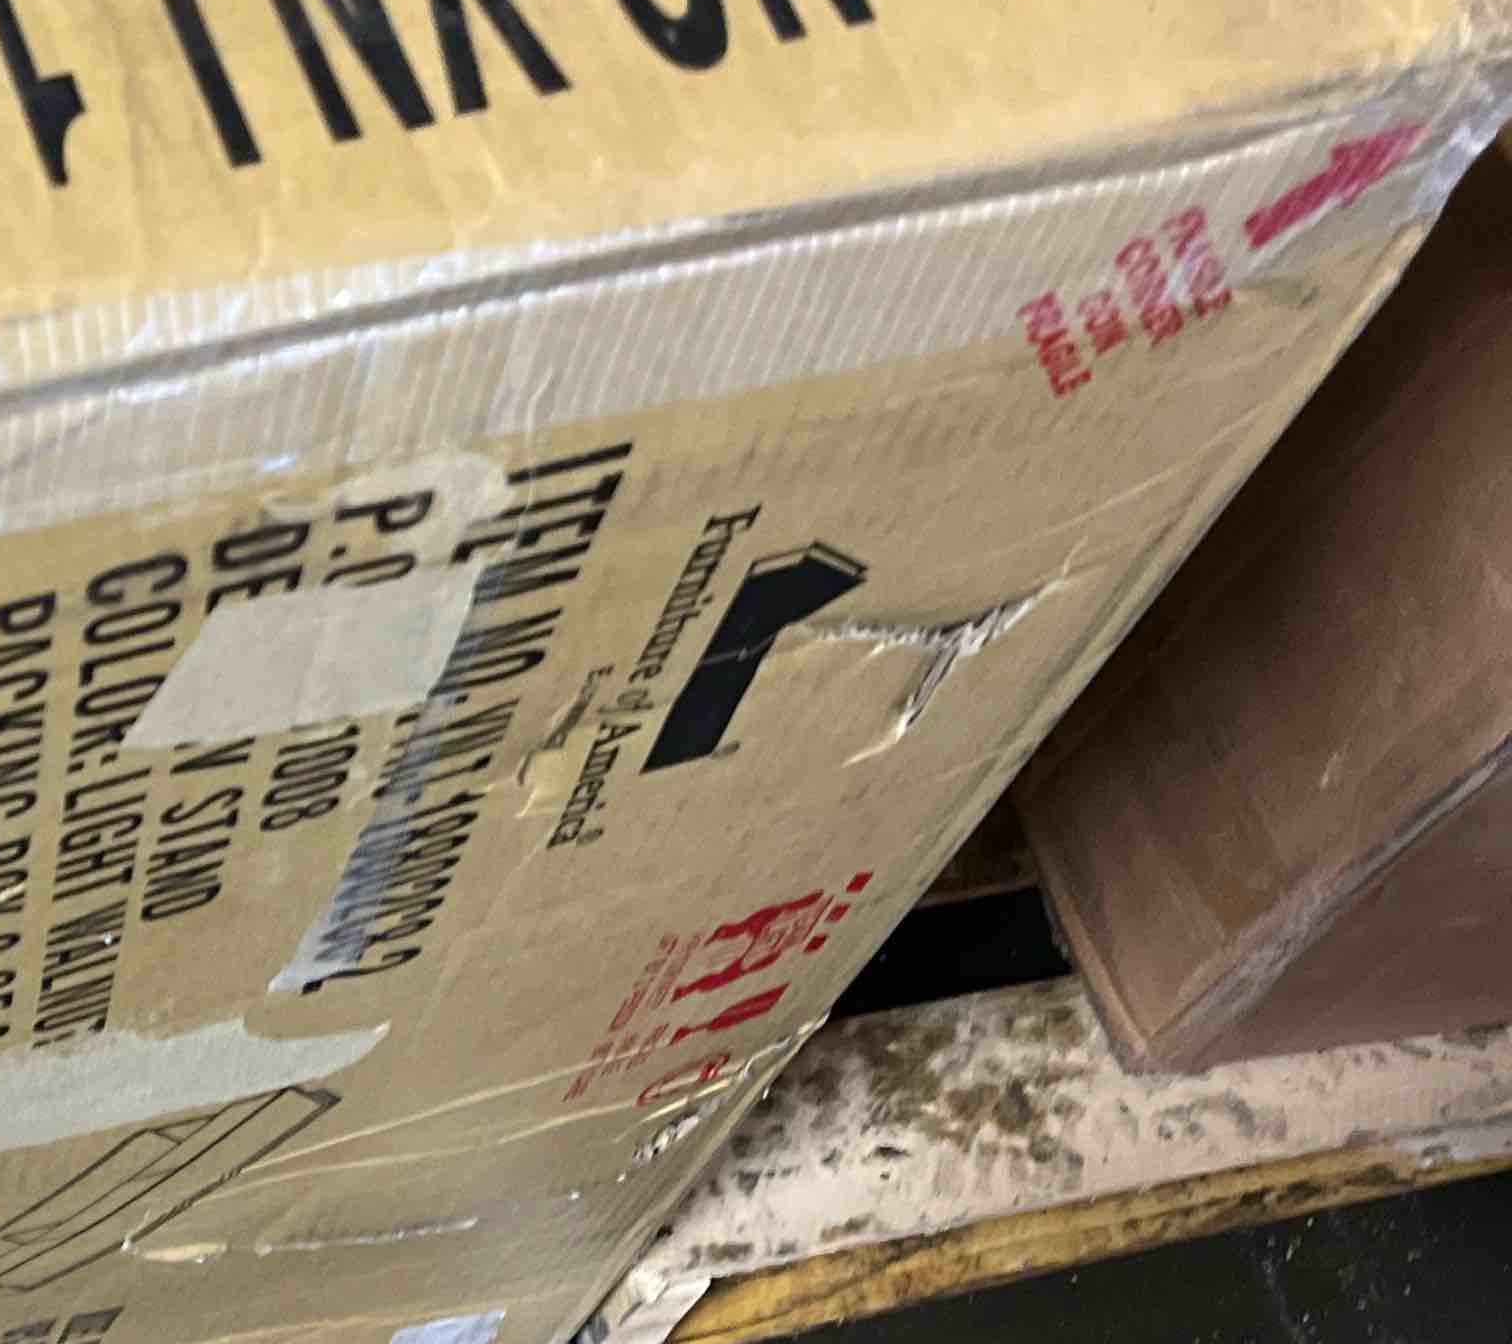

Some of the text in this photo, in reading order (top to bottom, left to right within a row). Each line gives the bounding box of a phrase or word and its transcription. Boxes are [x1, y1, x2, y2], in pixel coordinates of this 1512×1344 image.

[450, 442, 632, 605] ITEM
[628, 503, 763, 684] Furniture
[597, 689, 655, 714] of
[52, 766, 153, 902] LIGHT
[259, 716, 361, 832] 1008
[141, 786, 244, 923] STAND
[31, 898, 129, 1049] WALNUT
